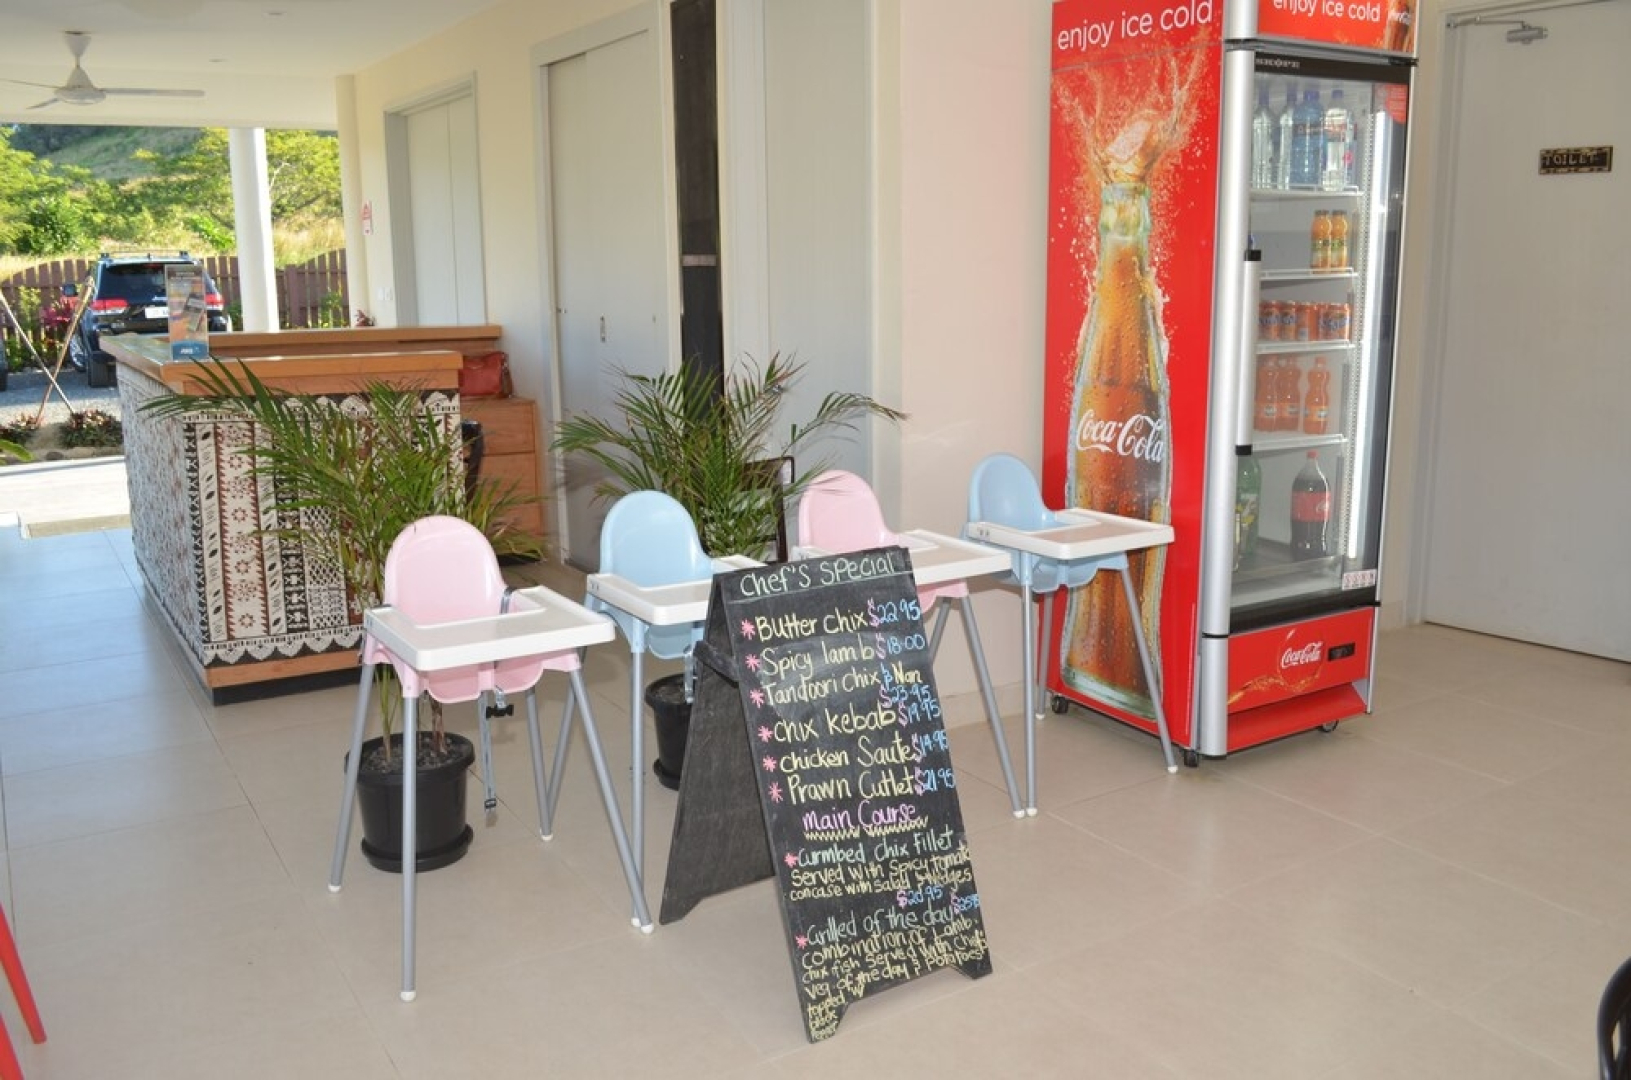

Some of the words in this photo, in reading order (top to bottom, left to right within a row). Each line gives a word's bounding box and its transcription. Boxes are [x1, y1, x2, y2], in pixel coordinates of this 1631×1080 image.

[1057, 19, 1115, 51] enjoy
[1120, 11, 1154, 39] ice
[1160, 0, 1213, 31] cold
[1273, 0, 1317, 17] enjoy
[1321, 0, 1343, 17] ice
[1347, 2, 1381, 22] cold
[1542, 152, 1597, 166] TOILET
[1076, 408, 1164, 463] Coca-Cola
[755, 611, 818, 642] Butter
[759, 646, 814, 680] Spicy
[761, 672, 838, 706] Tandoori
[824, 699, 897, 735] kebab
[780, 746, 850, 773] chicken
[787, 774, 853, 805] Prawn
[858, 766, 914, 799] Cutlet
[857, 799, 916, 827] Course
[806, 910, 857, 946] Grilled
[862, 908, 886, 933] of
[885, 905, 917, 930] the
